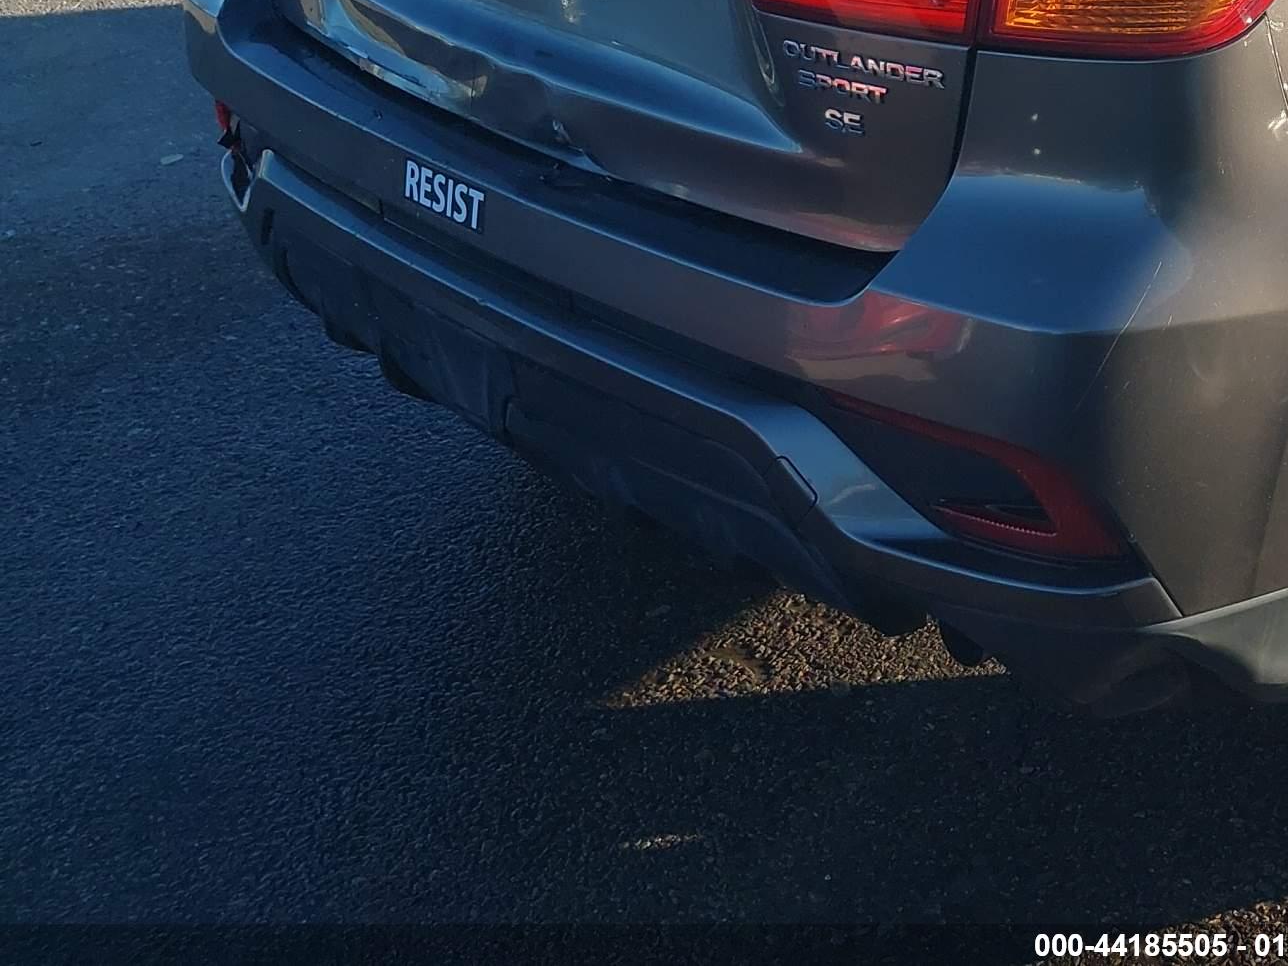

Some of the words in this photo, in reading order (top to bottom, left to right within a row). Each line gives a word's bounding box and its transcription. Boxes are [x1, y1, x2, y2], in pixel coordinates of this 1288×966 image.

[783, 39, 945, 89] OUTLANDER
[797, 69, 888, 104] SPORT
[825, 108, 863, 134] SE
[405, 160, 485, 230] RESIST
